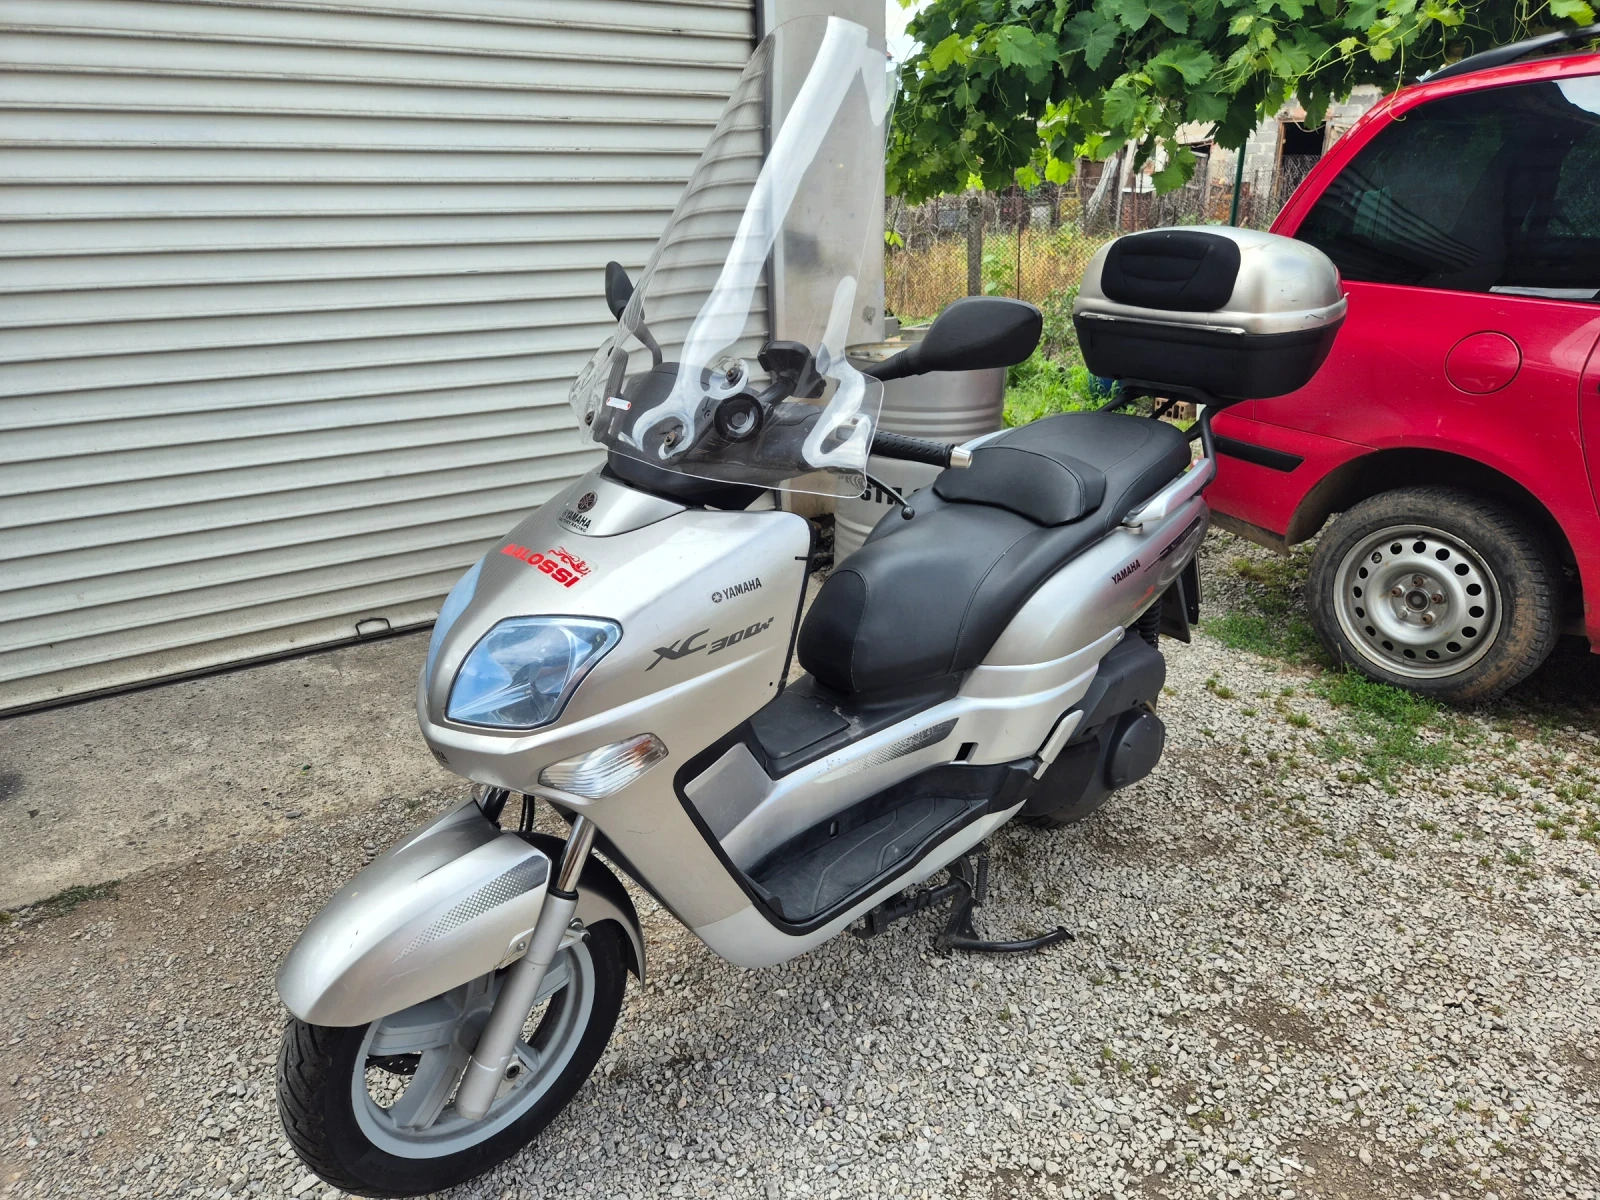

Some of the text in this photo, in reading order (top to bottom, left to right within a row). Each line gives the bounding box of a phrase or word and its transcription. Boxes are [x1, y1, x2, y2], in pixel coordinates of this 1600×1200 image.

[566, 511, 592, 529] YAMAHA
[1112, 560, 1141, 585] YAMAHA
[722, 577, 762, 600] YAMAHA
